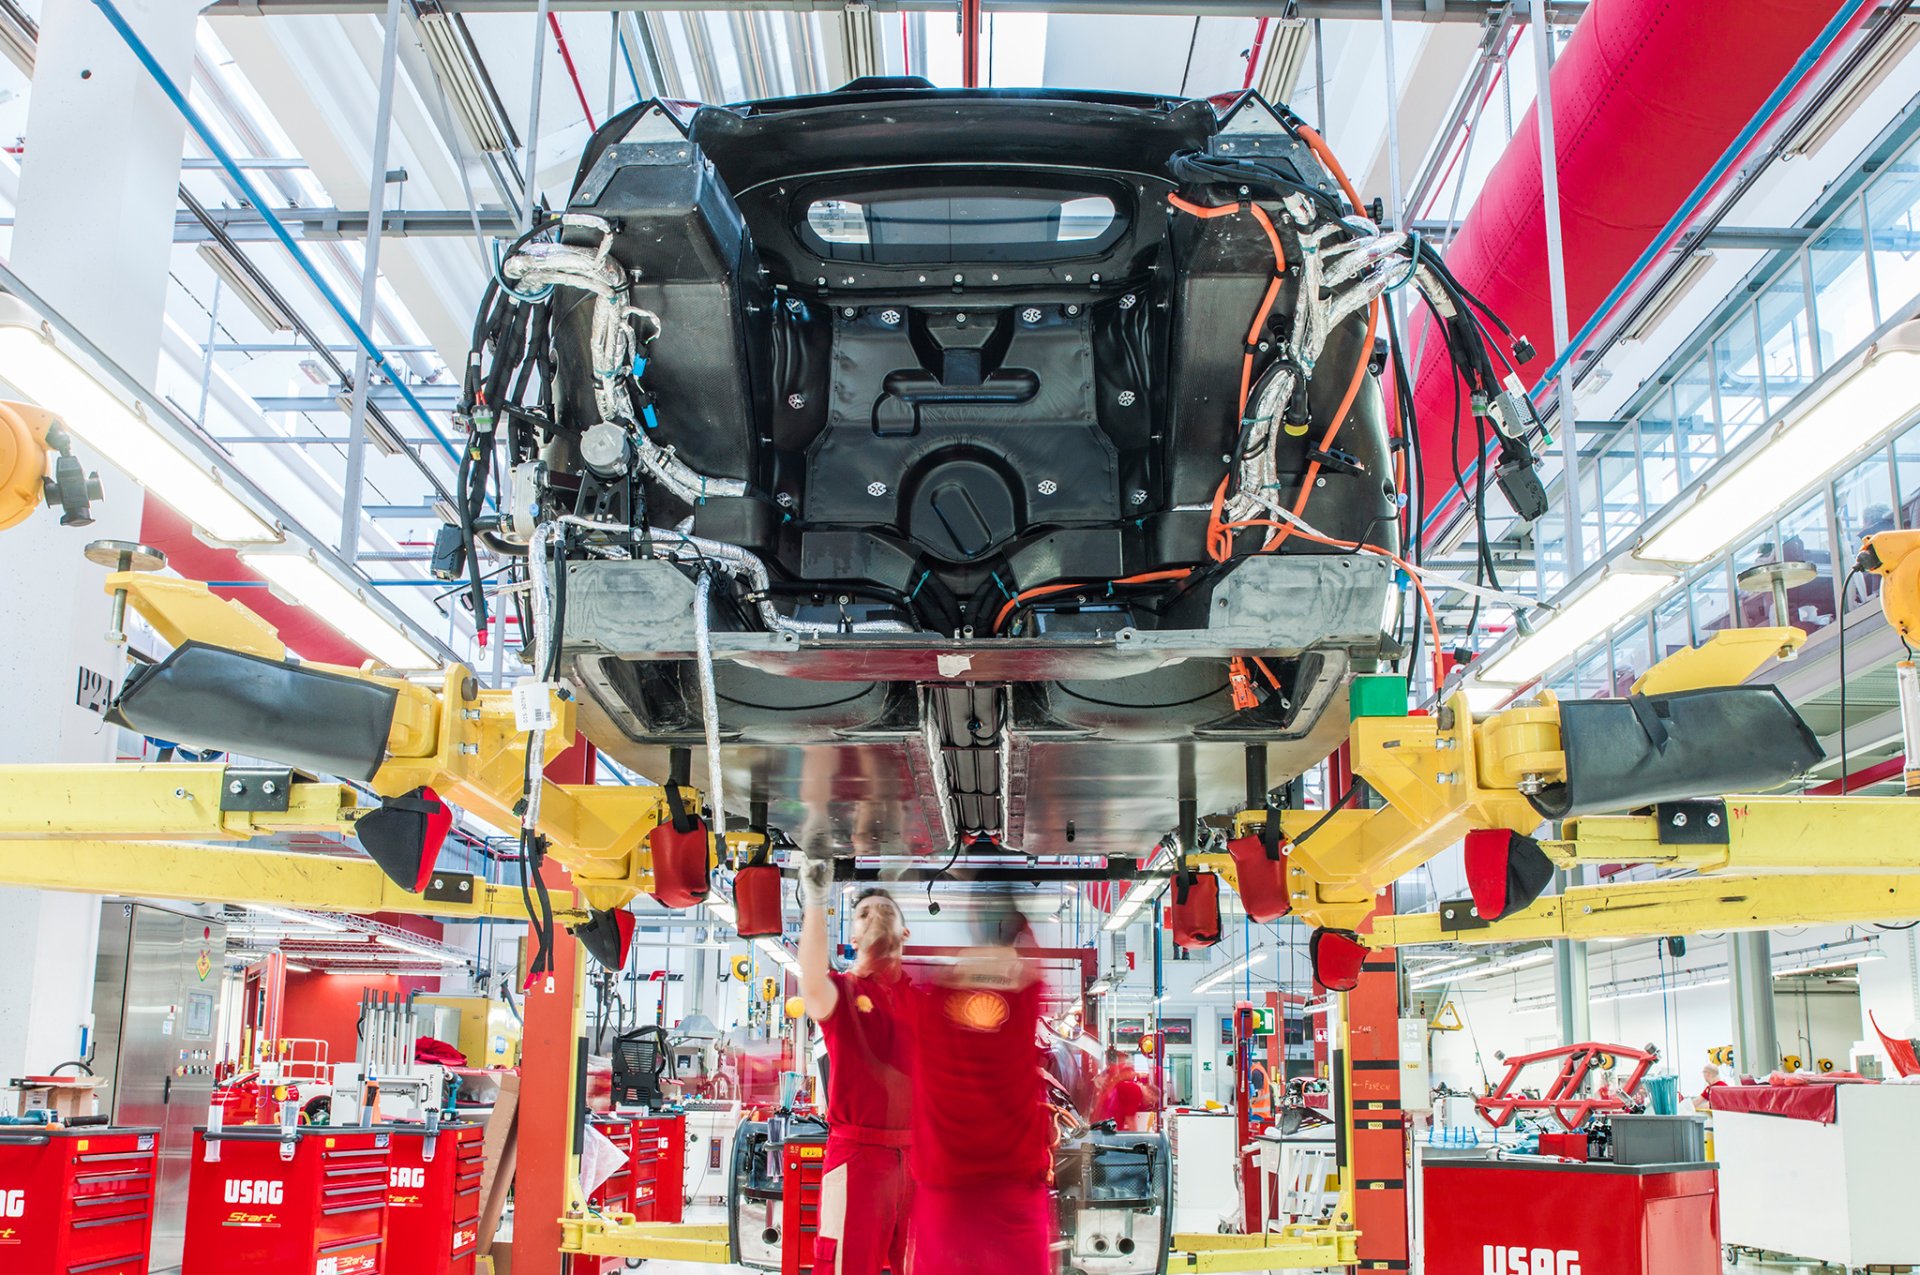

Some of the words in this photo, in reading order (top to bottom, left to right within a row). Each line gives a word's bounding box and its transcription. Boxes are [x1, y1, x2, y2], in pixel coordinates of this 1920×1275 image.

[224, 1179, 283, 1205] USAG
[228, 1212, 276, 1222] Start
[1483, 1245, 1581, 1275] USAG
